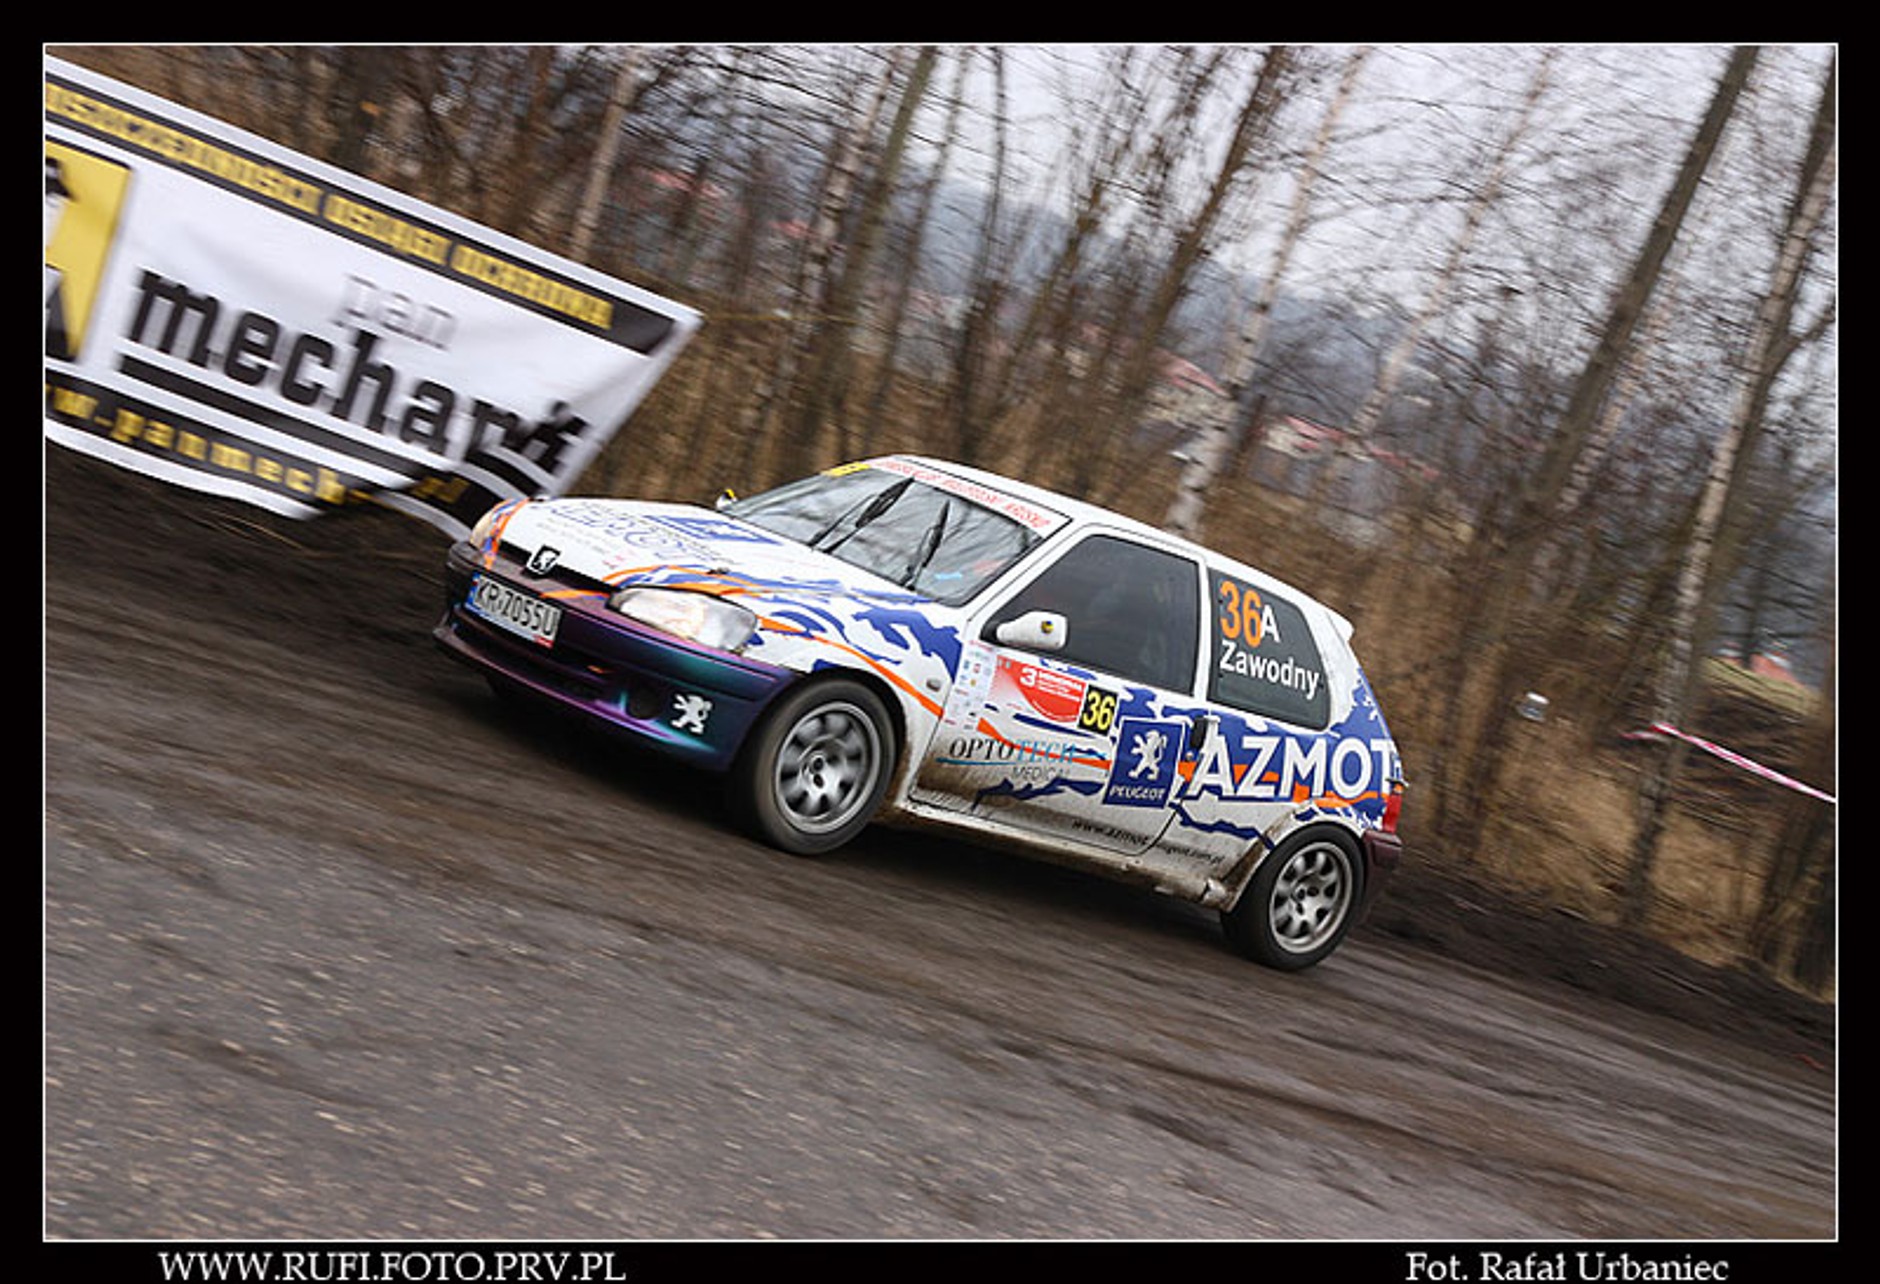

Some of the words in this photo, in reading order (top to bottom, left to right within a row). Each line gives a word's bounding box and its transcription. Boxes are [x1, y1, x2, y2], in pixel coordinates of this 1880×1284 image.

[333, 274, 453, 349] pan
[1020, 667, 1037, 687] 3
[1220, 640, 1320, 700] Zawodny
[1083, 690, 1115, 730] 36
[950, 738, 1077, 764] OPTOTECH
[1186, 735, 1396, 797] AZMOT
[1109, 785, 1166, 801] PEUGEOT
